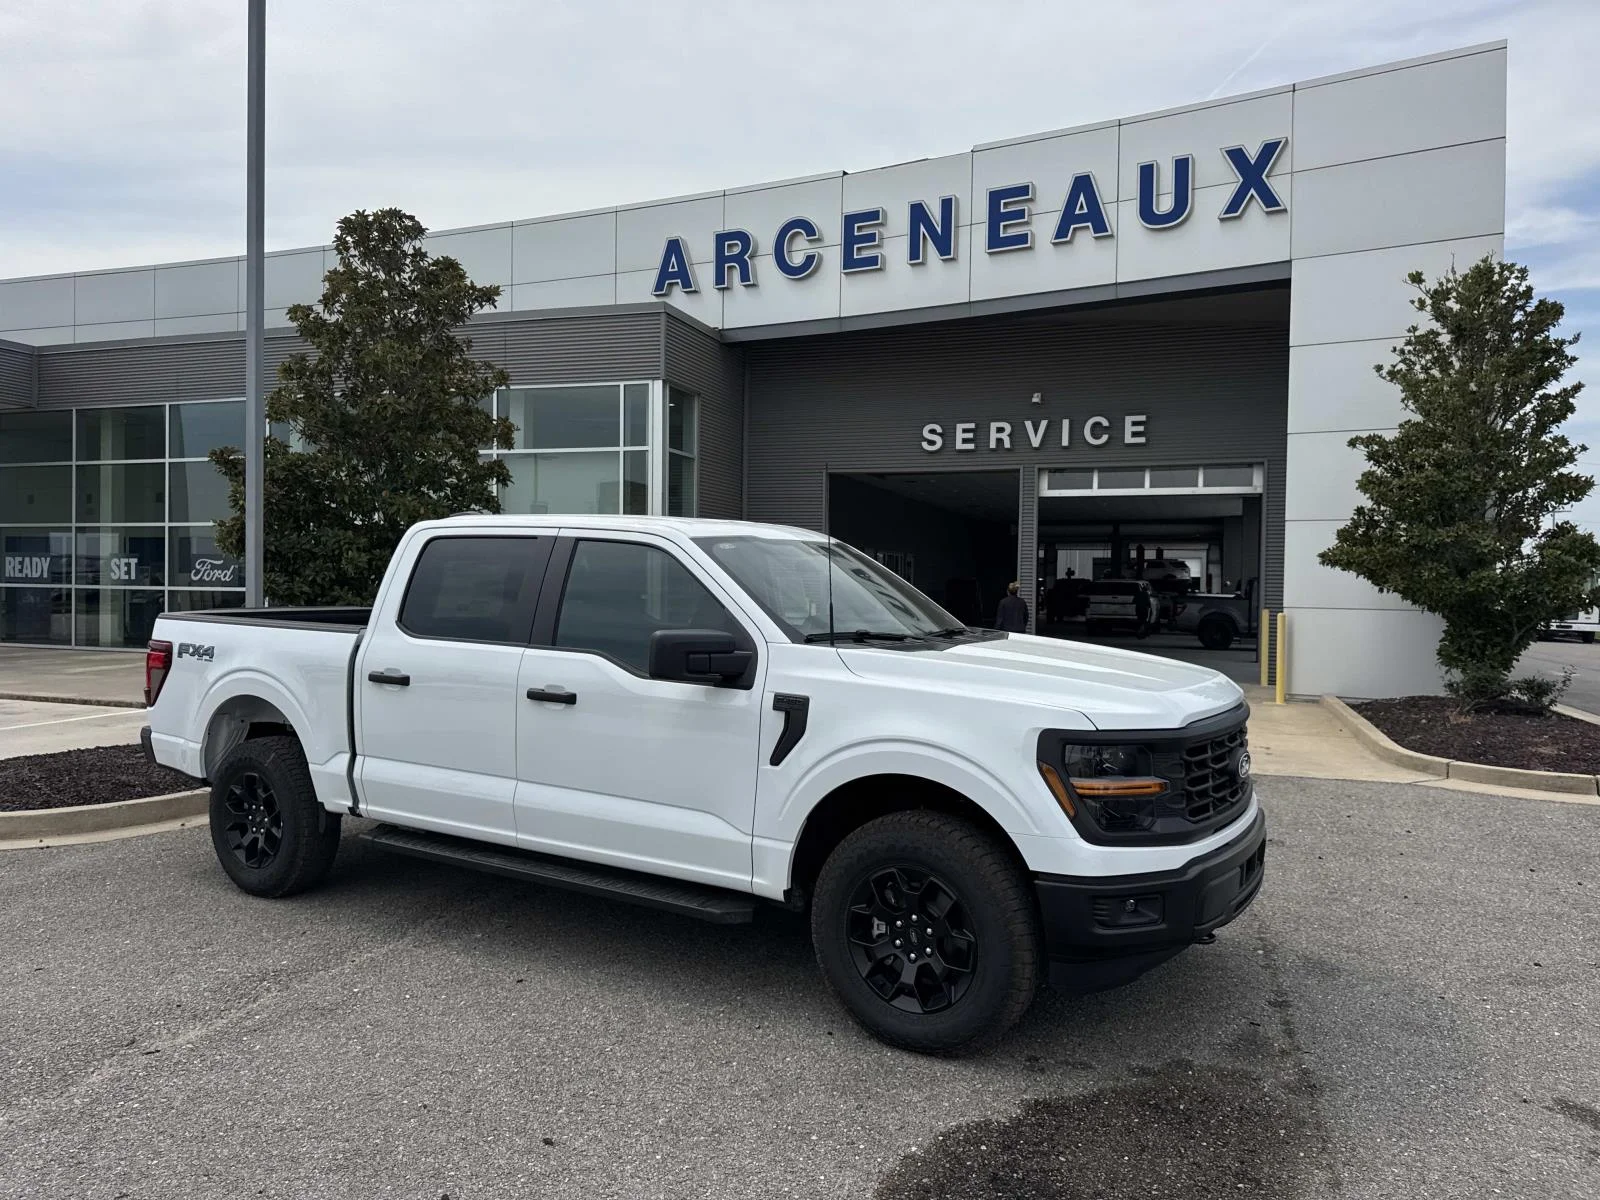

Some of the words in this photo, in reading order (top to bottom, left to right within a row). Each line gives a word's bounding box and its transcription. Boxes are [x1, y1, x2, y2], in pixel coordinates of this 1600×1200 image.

[652, 136, 1289, 296] ARCENEAUX
[921, 415, 1147, 451] SERVICE
[5, 556, 50, 578] READY
[110, 558, 138, 580] SET
[191, 558, 234, 582] Ford
[177, 642, 215, 659] FX4
